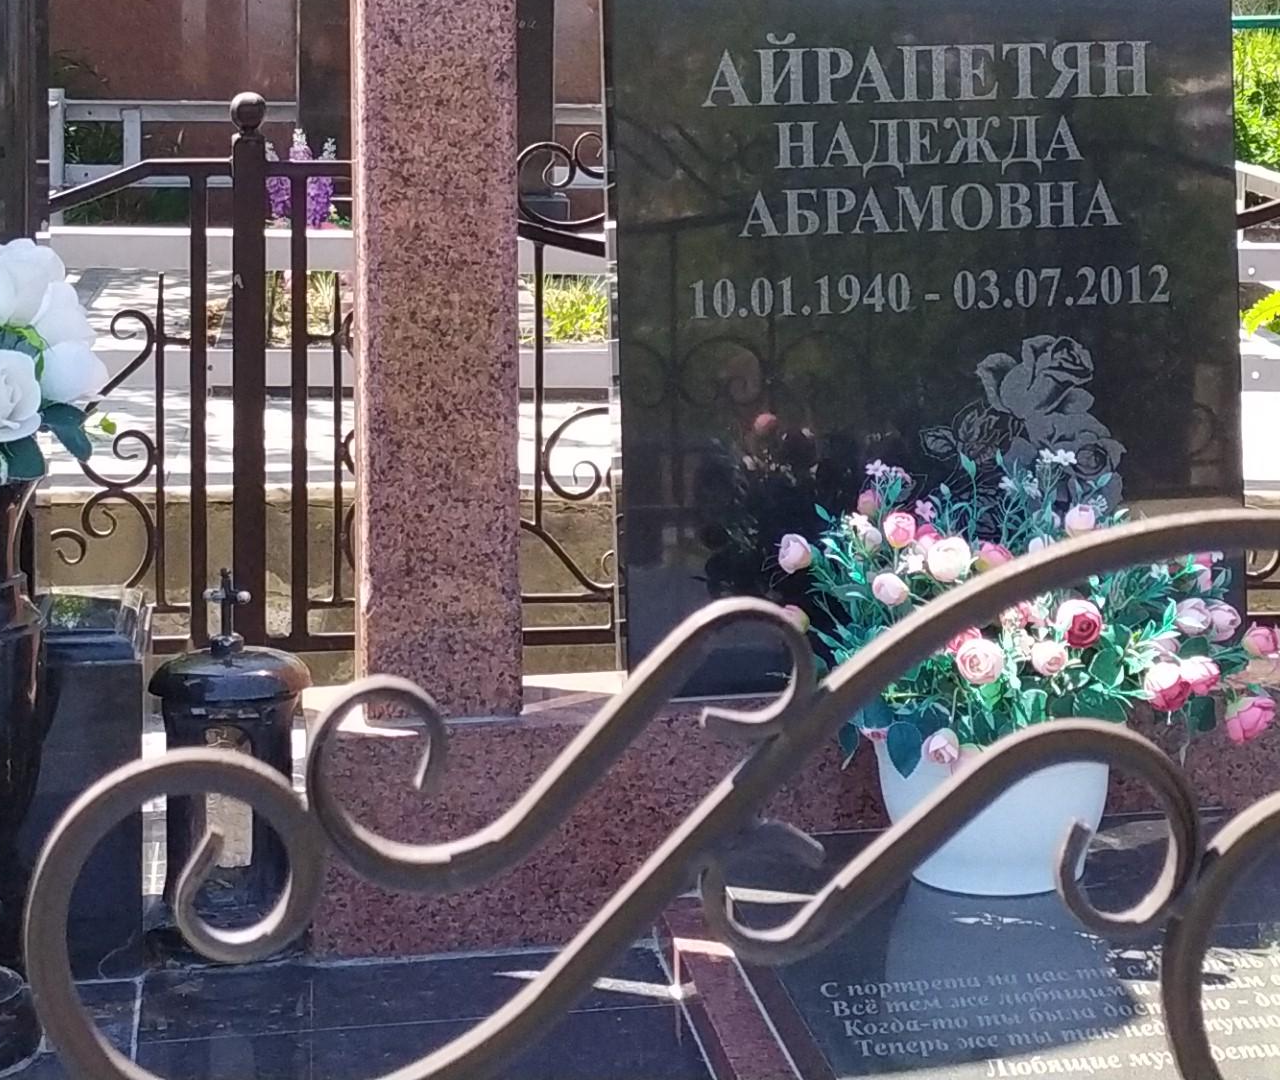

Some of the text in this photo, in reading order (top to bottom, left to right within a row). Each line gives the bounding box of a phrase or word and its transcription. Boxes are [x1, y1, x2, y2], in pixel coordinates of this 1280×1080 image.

[702, 32, 1152, 108] АЙРАПЕТЯН
[774, 115, 1084, 179] НАДЕЖДА
[739, 179, 1122, 237] АБРАМОВНА
[689, 272, 913, 319] 10.01.1940
[953, 265, 1171, 311] 03.07.2012
[821, 982, 839, 998] С
[847, 976, 982, 999] портрета
[832, 999, 879, 1017] Всё
[886, 998, 943, 1014] тем
[950, 993, 990, 1009] же
[844, 1016, 968, 1037] Когда-то
[977, 1012, 1022, 1027] ты
[1029, 1006, 1096, 1024] была
[855, 1037, 949, 1057] Теперь
[957, 1033, 998, 1049] же
[1007, 1030, 1052, 1047] ты
[1061, 1025, 1119, 1043] так
[986, 1054, 1122, 1079] Любящие
